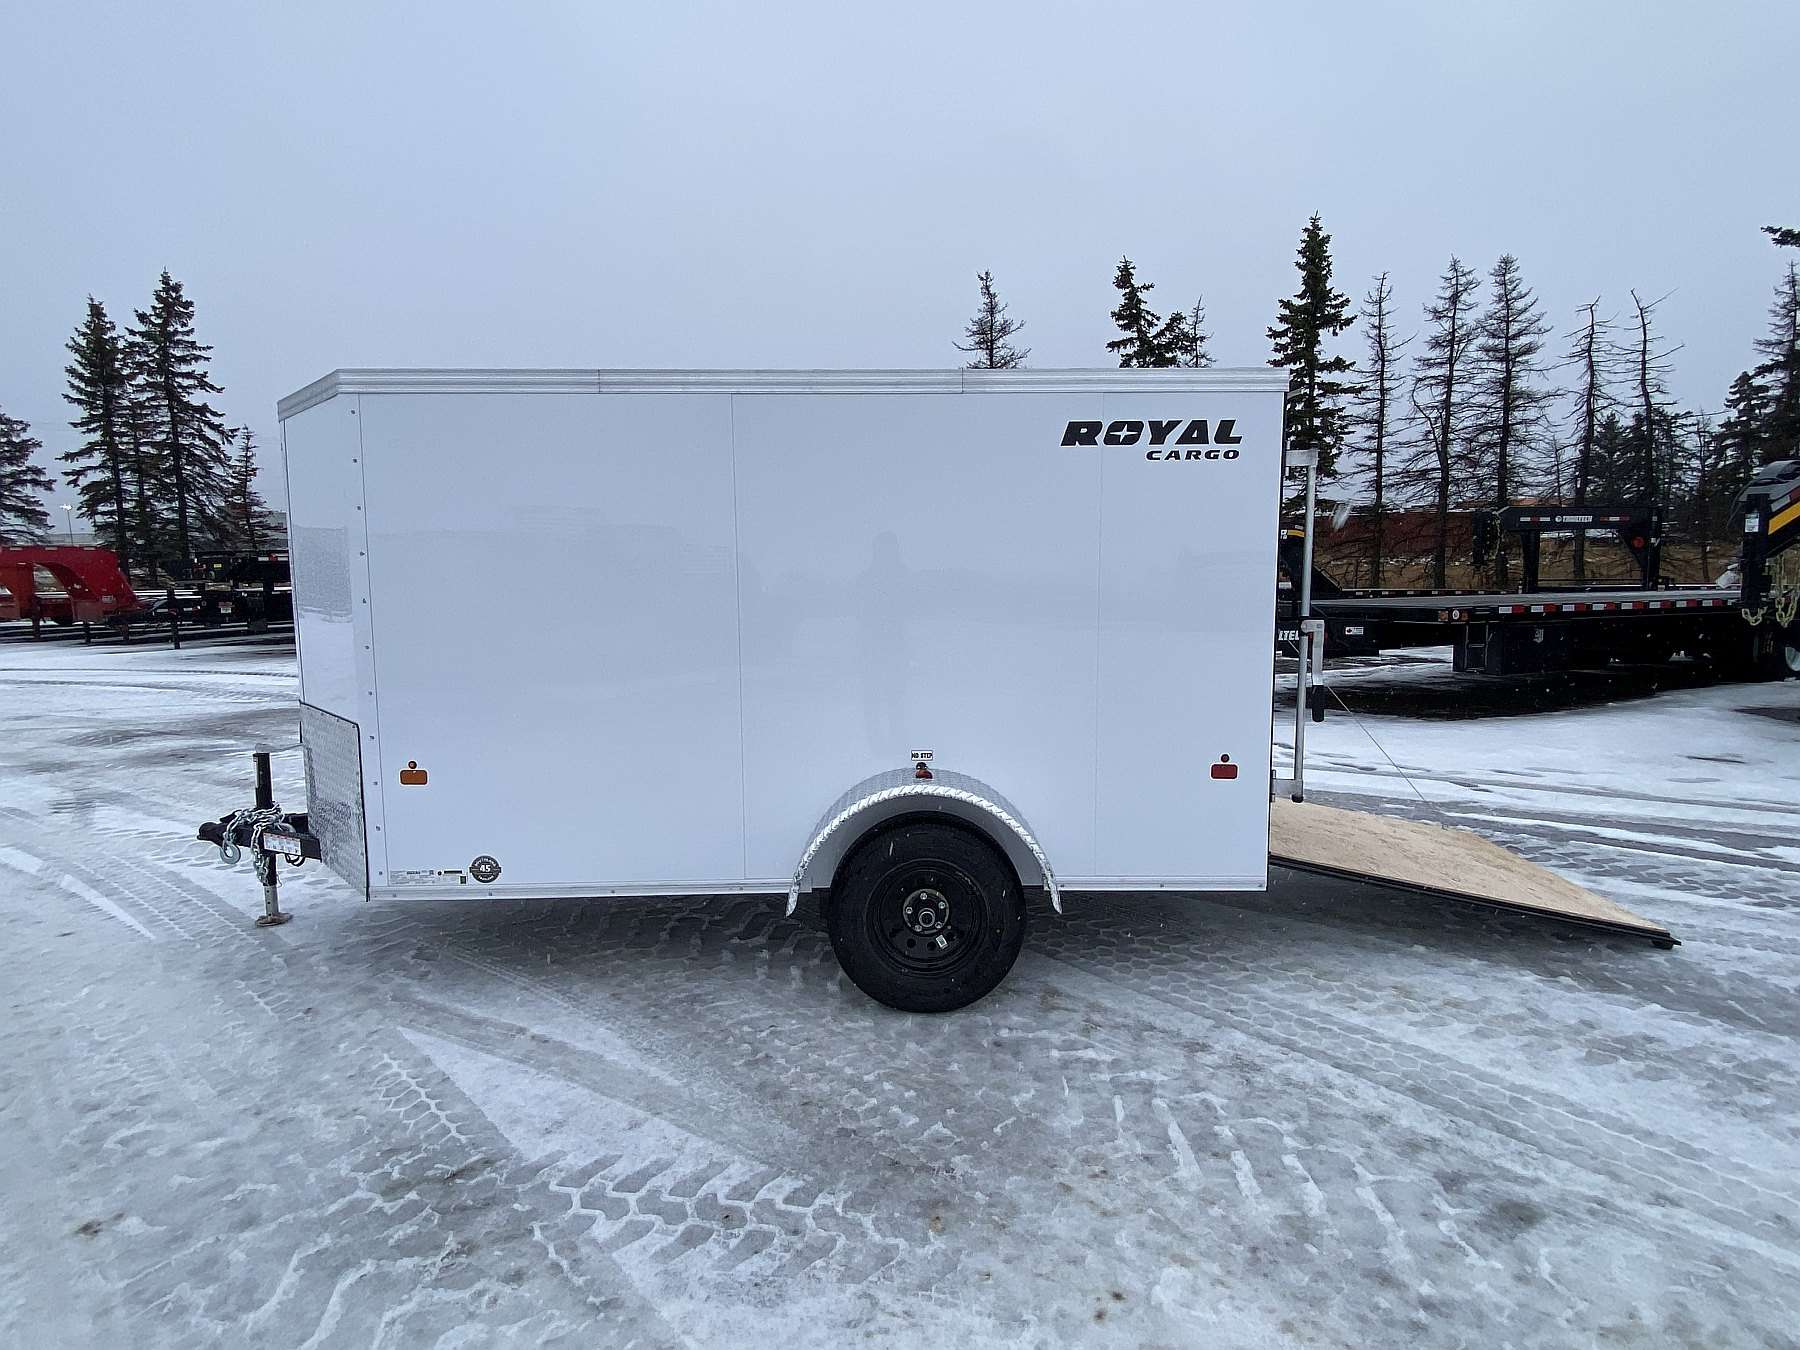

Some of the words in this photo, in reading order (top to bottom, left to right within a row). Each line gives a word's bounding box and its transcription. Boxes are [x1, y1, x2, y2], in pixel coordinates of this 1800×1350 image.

[1060, 419, 1243, 447] ROYAL
[1146, 449, 1240, 461] CARGO
[479, 864, 491, 873] 45
